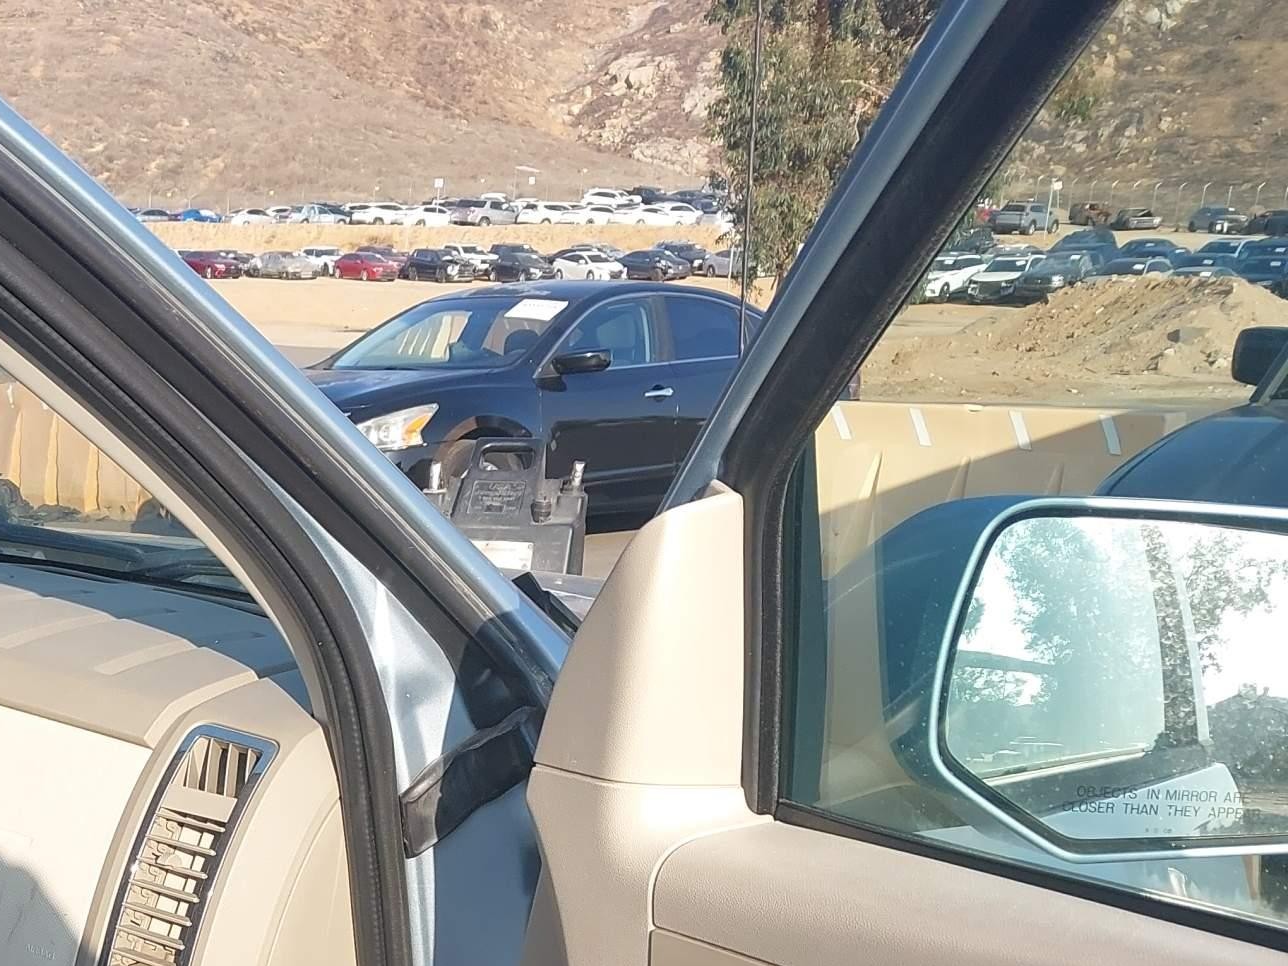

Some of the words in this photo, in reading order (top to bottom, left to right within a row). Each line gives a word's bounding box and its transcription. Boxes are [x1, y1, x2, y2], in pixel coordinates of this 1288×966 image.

[1076, 786, 1138, 799] OBJECTS
[1147, 789, 1160, 799] IN
[1165, 790, 1217, 802] MIRROR
[1223, 792, 1249, 803] ARE
[1062, 801, 1115, 814] CLOSER
[1123, 803, 1159, 816] THAN
[1168, 805, 1201, 818] THEY
